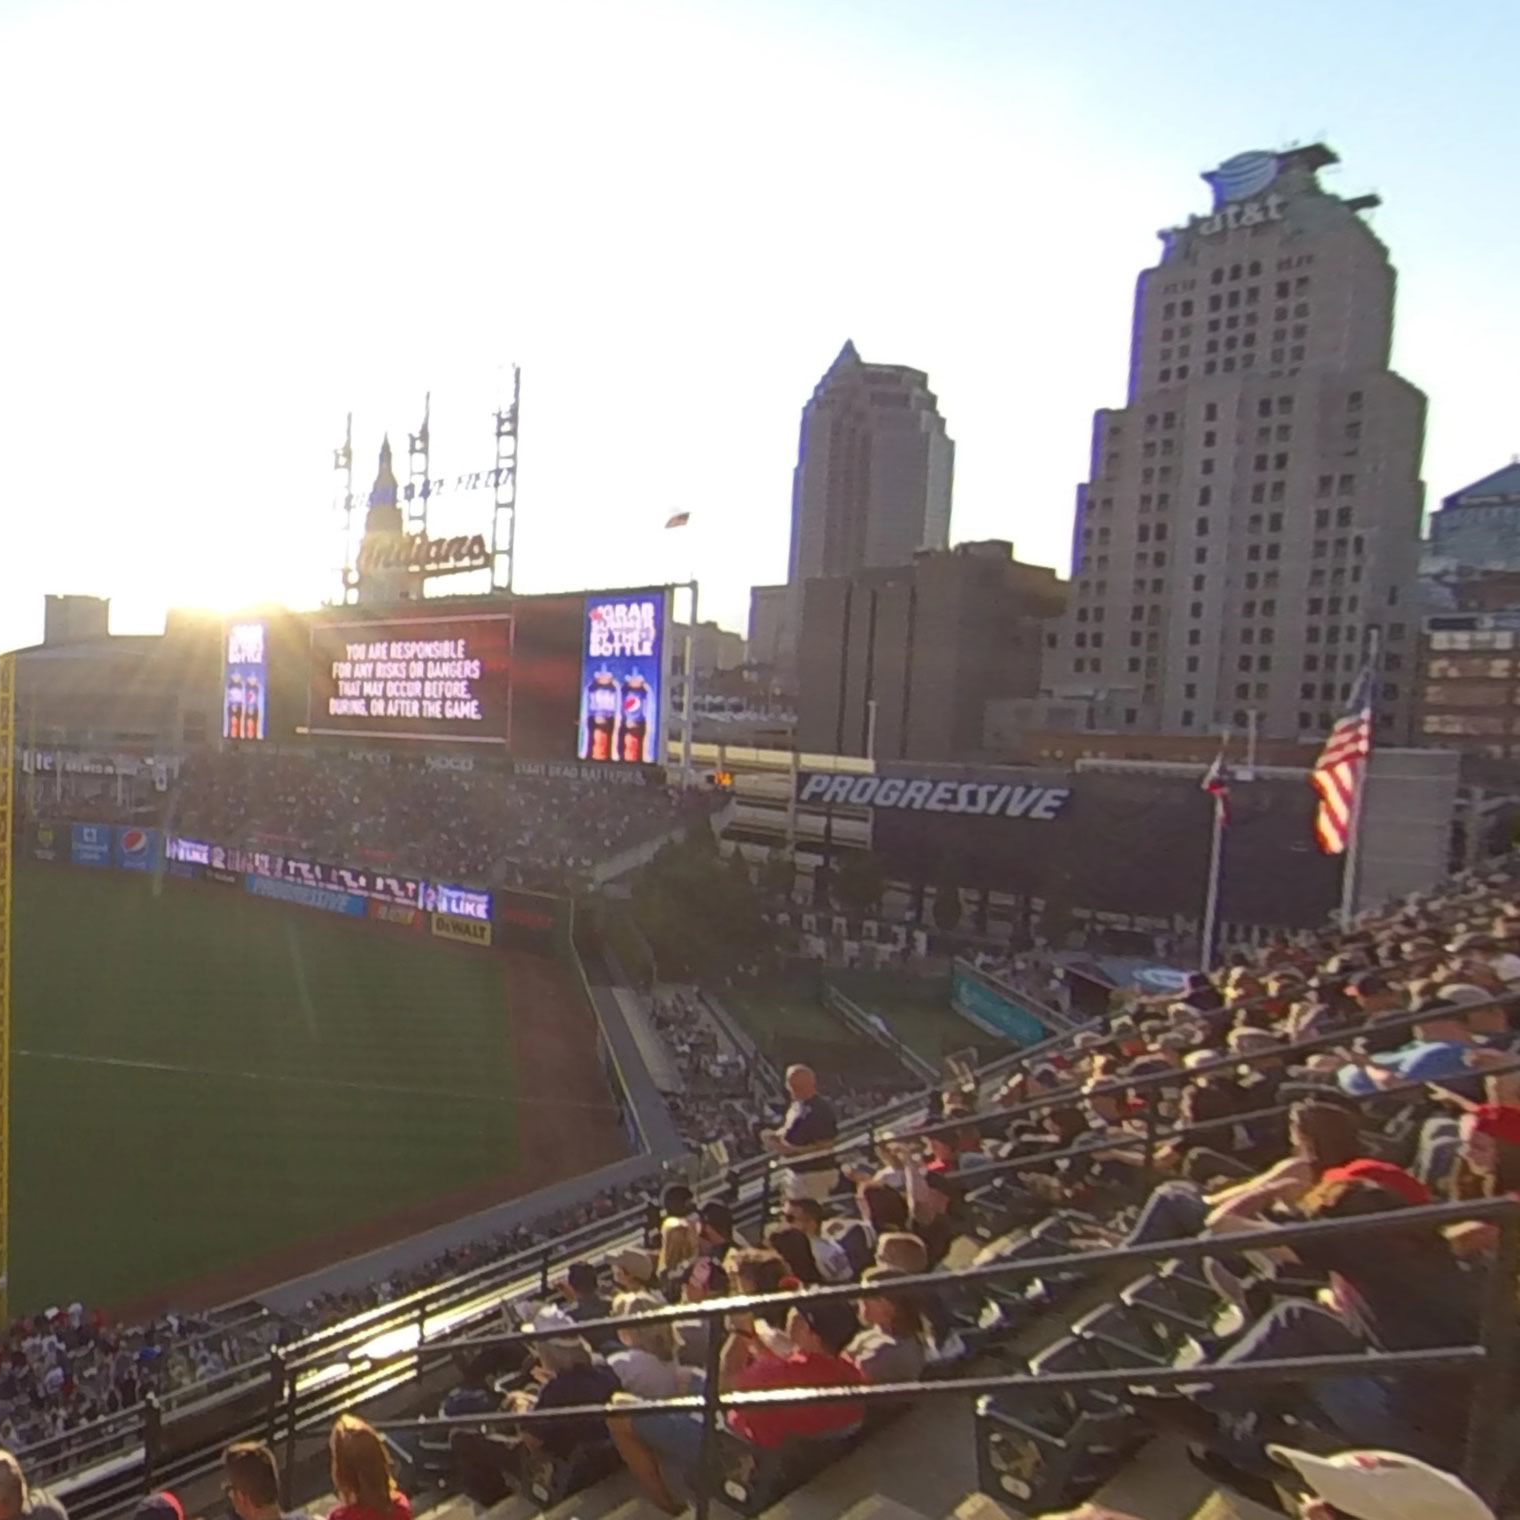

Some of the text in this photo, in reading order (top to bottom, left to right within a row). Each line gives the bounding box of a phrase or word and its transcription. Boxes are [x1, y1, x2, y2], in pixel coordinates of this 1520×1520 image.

[1199, 194, 1284, 236] at&t
[346, 639, 466, 660] YOU ARE RESPONSIBLE
[332, 659, 480, 680] FOR ANY RISKS OR DANGERS
[338, 680, 361, 697] THAT
[363, 680, 384, 697] MAY
[386, 680, 422, 698] OCCUR
[370, 699, 385, 717] OR
[386, 699, 420, 718] AFTER
[422, 700, 443, 719] THE
[799, 774, 1070, 820] PROGRESSIVE
[450, 897, 488, 919] LIKE
